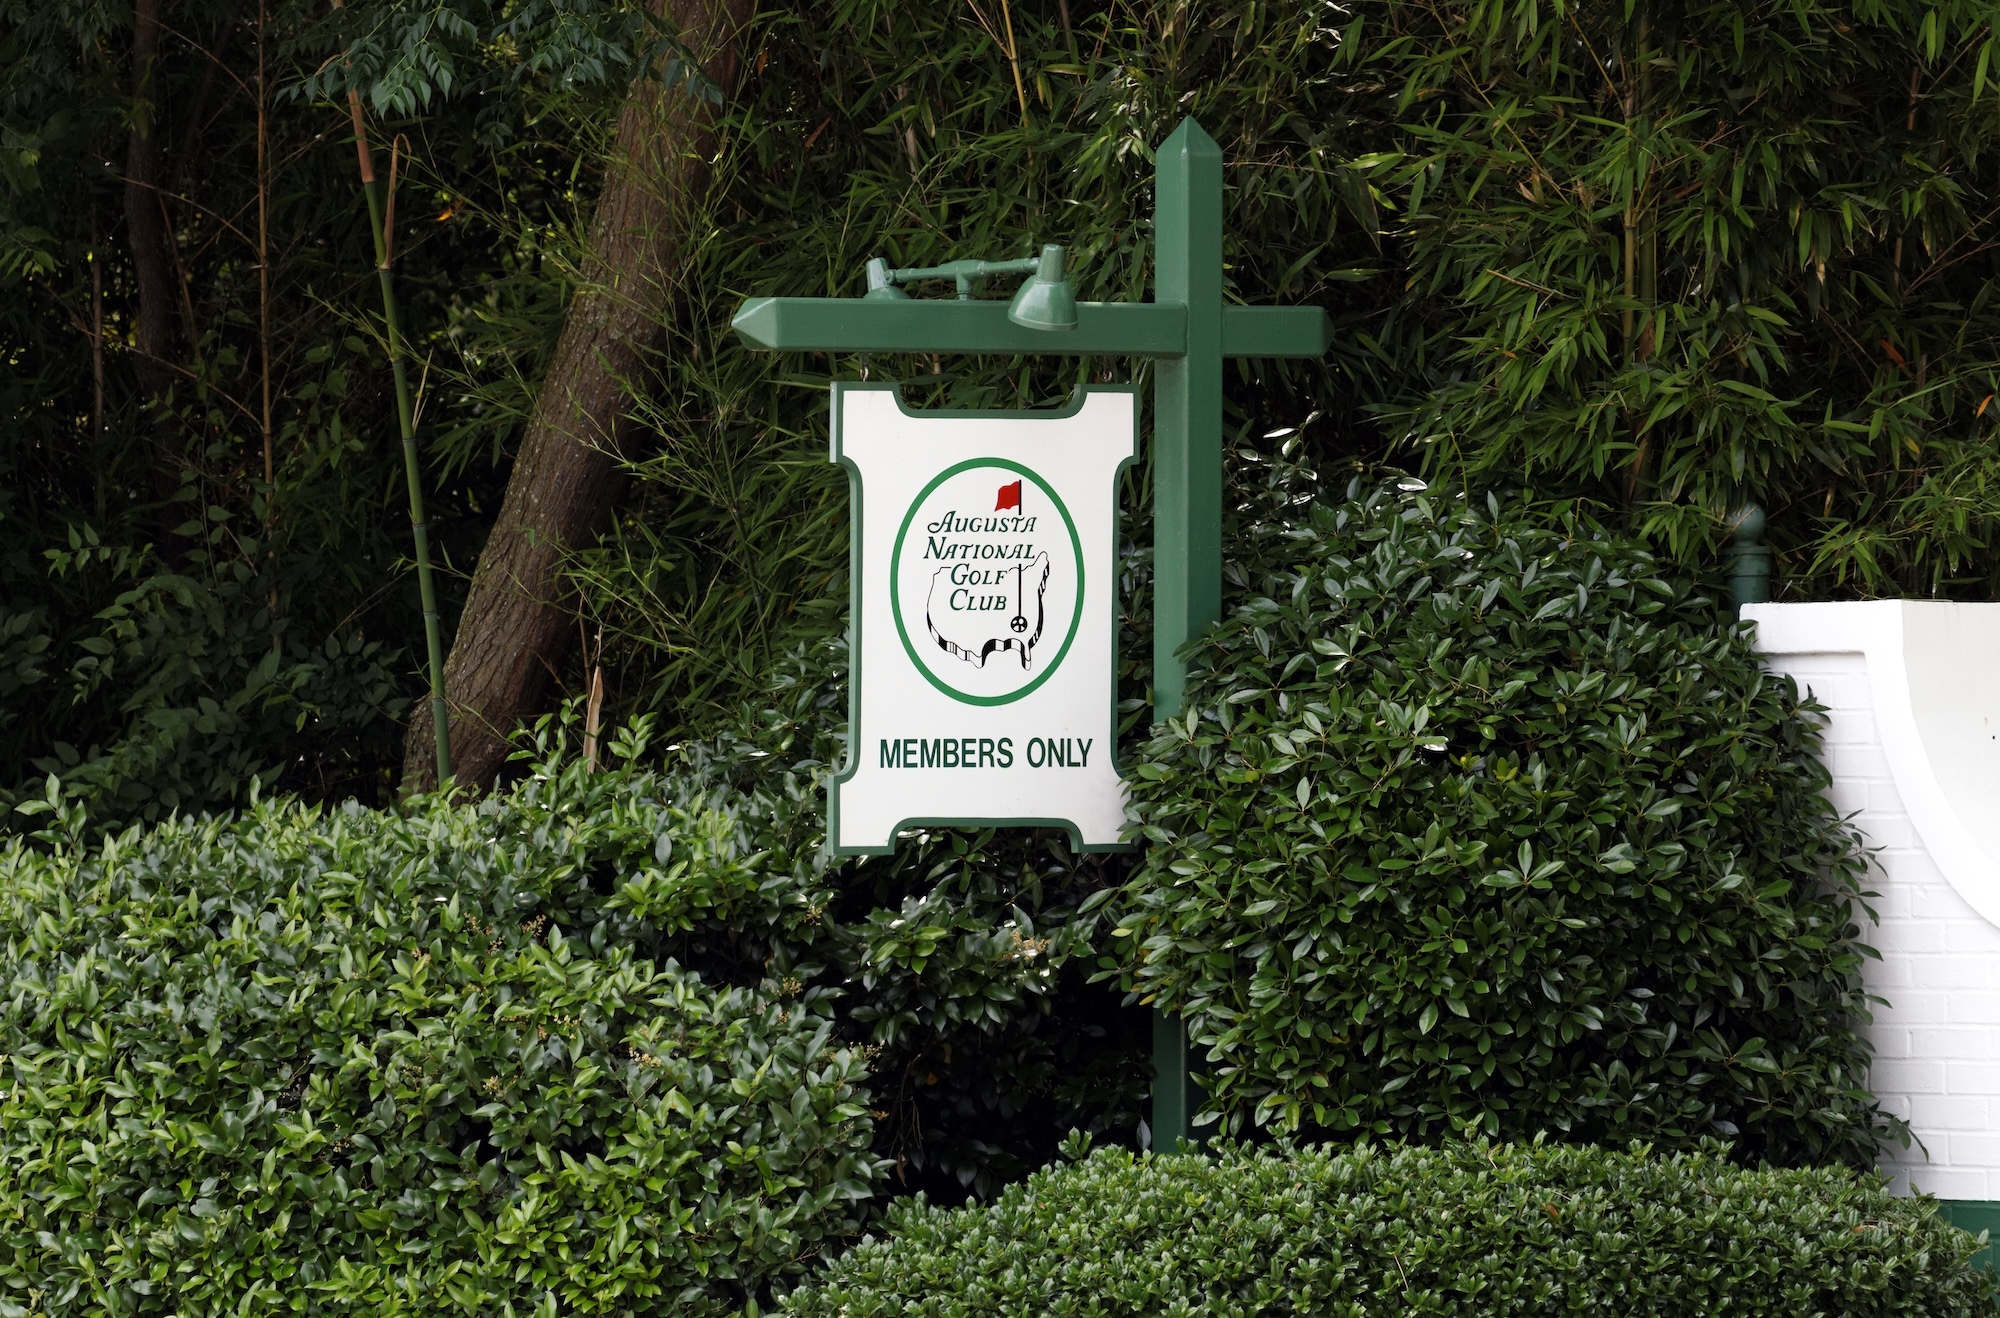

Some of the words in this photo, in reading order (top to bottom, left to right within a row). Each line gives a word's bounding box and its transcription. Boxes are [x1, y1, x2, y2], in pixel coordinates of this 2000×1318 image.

[927, 510, 1037, 533] AUGUSTA
[923, 536, 1036, 560] NATIONAL
[950, 563, 1008, 585] GOLF
[949, 588, 1007, 611] CLUB
[880, 738, 1014, 769] MEMBERS
[1026, 737, 1094, 769] ONLY
